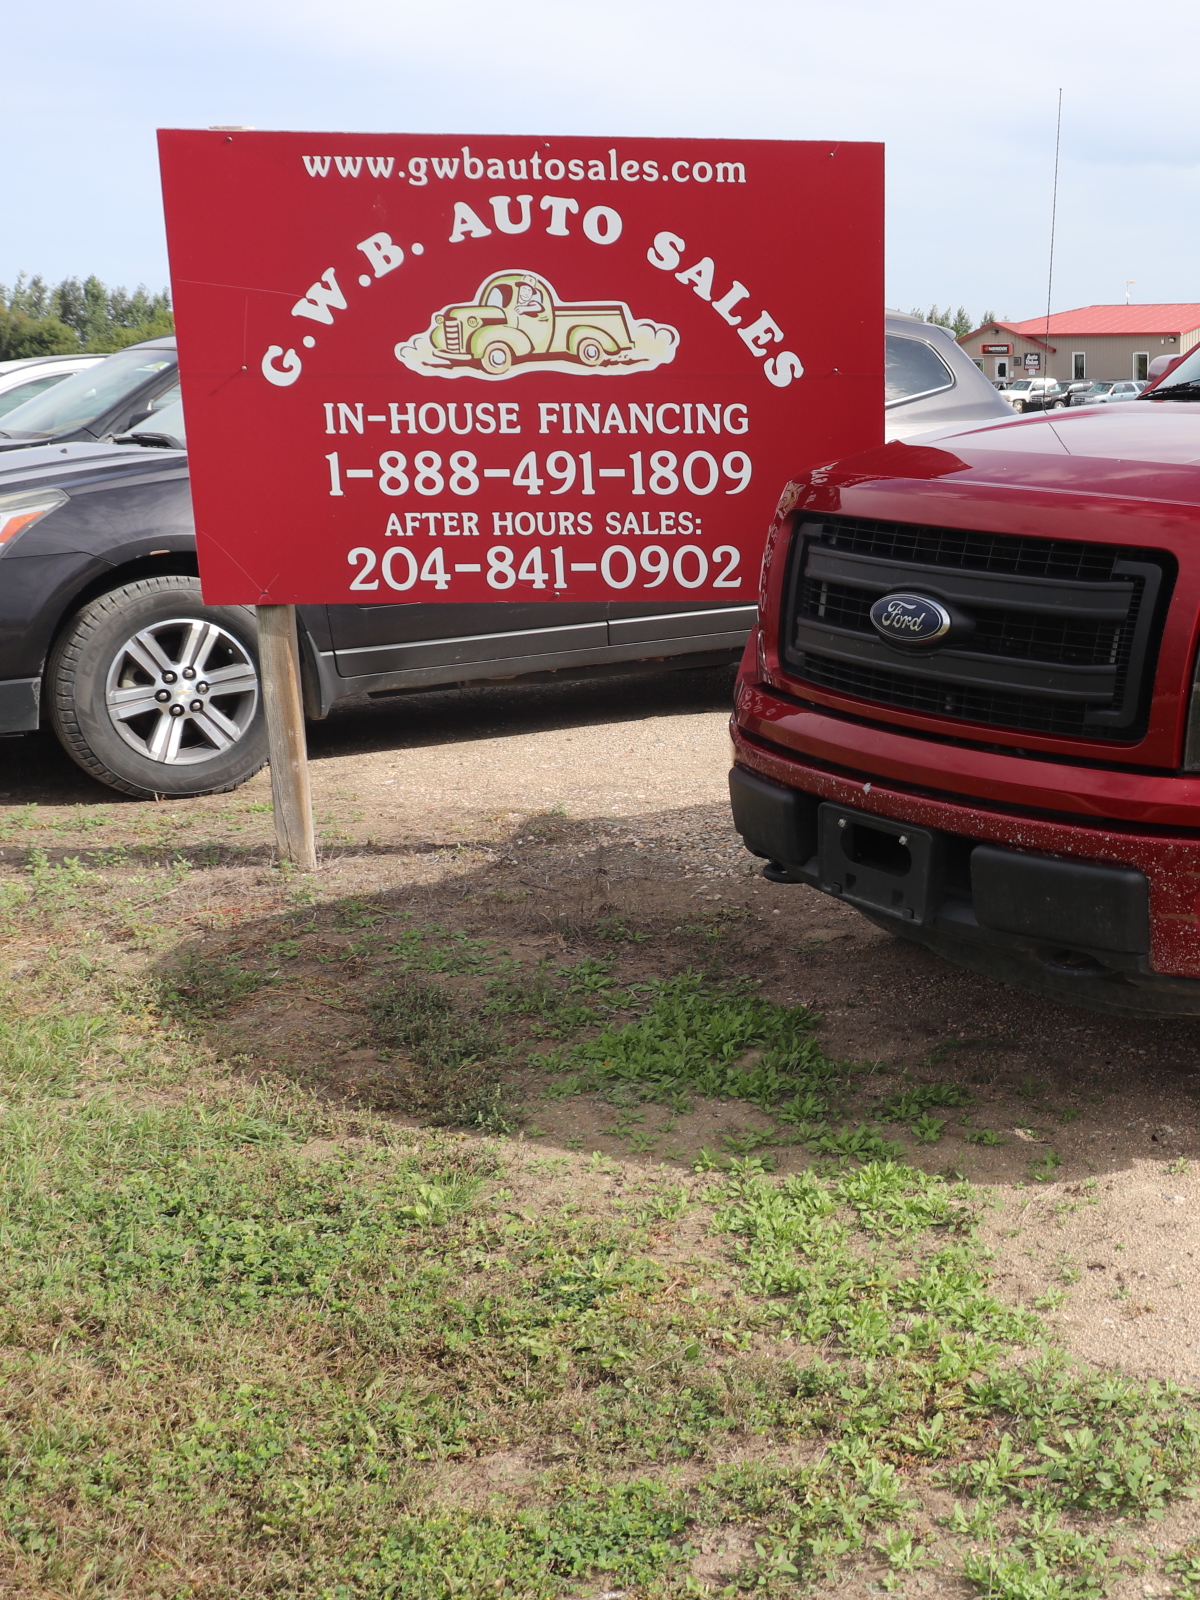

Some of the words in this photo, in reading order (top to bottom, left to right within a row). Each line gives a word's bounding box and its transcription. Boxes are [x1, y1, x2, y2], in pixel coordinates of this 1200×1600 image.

[301, 145, 747, 187] www.gwbautosales.com
[261, 231, 425, 387] G.W.B.
[448, 194, 623, 245] AUTO
[646, 231, 805, 388] SALES
[322, 402, 522, 435] IN-HOUSE
[537, 402, 749, 435] FINANCING
[324, 450, 753, 497] 1-888-491-1809
[384, 511, 480, 537] AFTER
[491, 511, 593, 536] HOURS
[605, 511, 703, 536] SALES:
[347, 544, 742, 592] 204-841-0902
[881, 600, 926, 632] Ford
